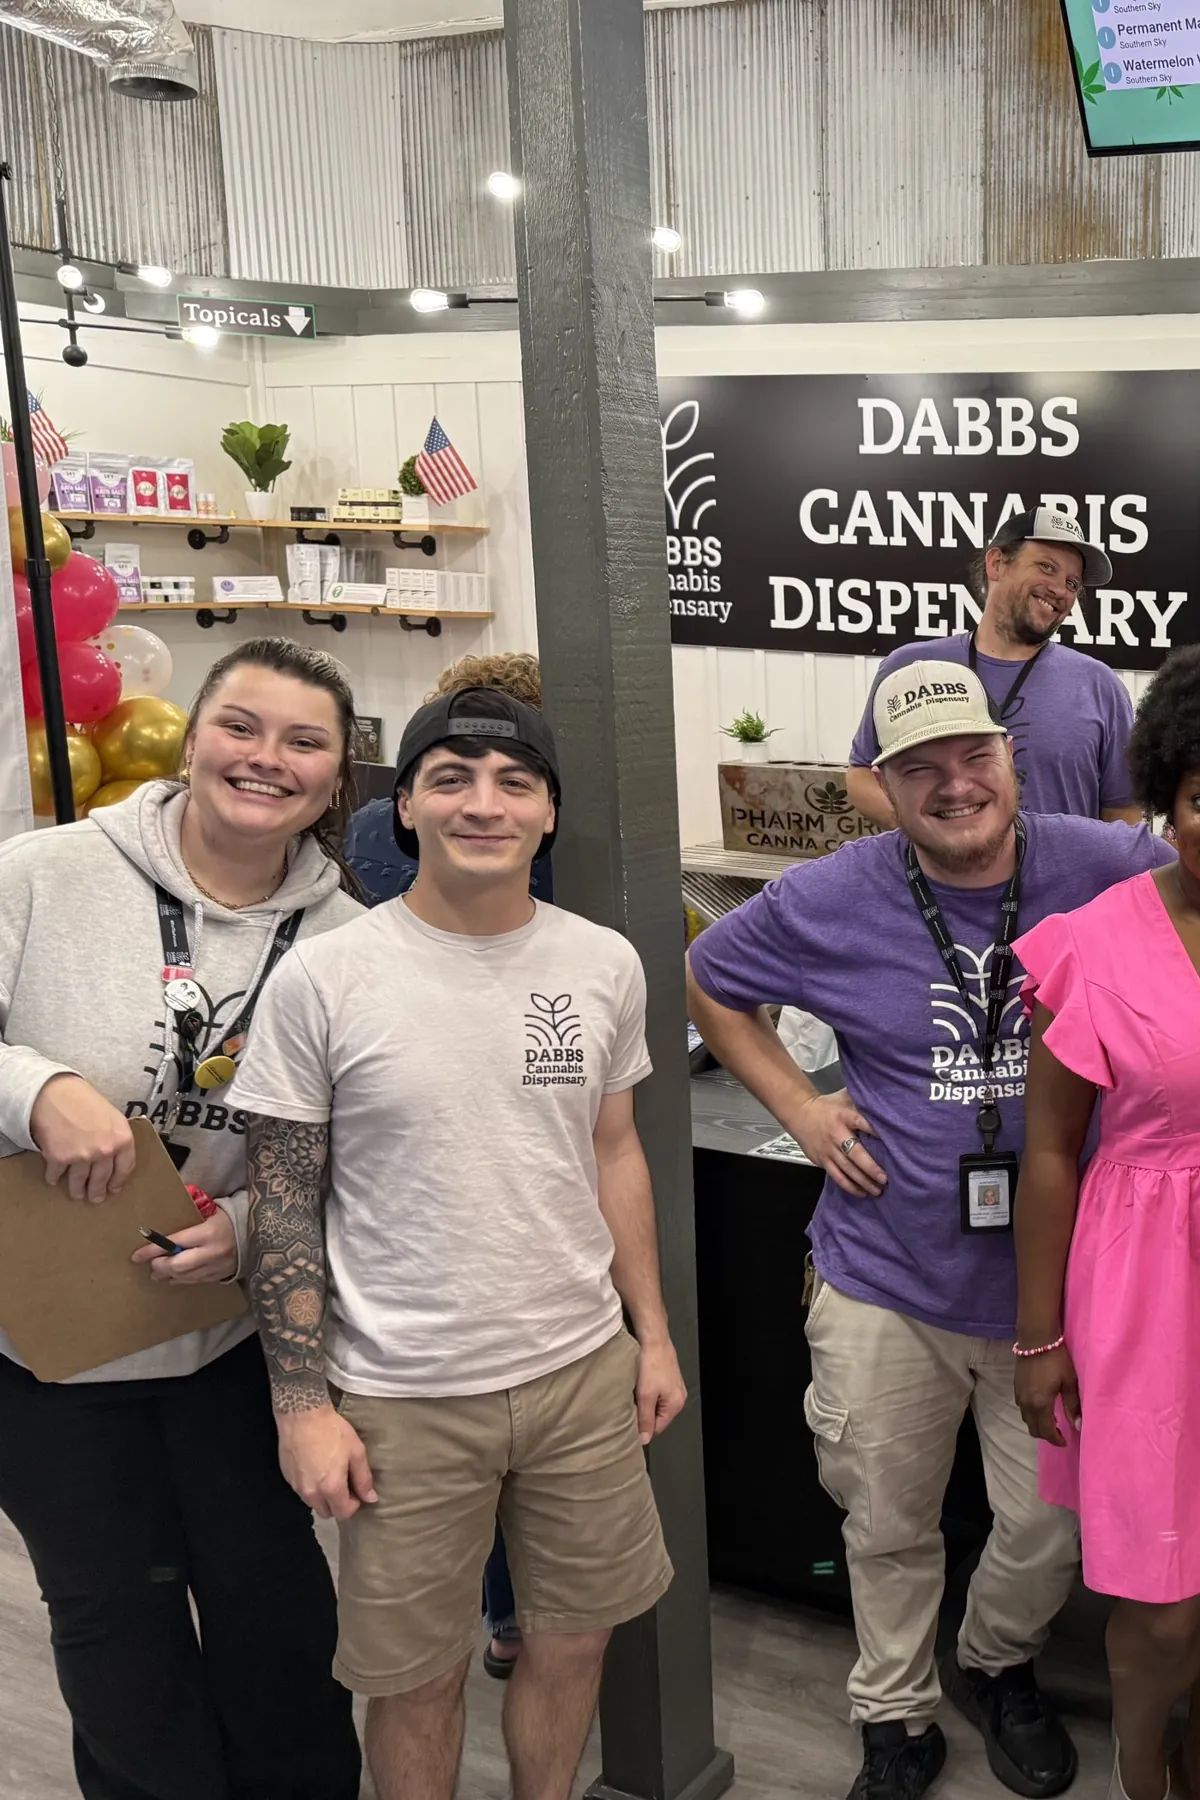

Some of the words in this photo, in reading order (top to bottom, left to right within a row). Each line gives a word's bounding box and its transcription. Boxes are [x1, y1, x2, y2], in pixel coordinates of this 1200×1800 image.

[1113, 4, 1147, 14] Southern
[1147, 1, 1161, 12] Sky
[1117, 19, 1183, 36] Permanent
[1120, 39, 1153, 49] Southern
[1153, 38, 1167, 48] Sky
[1122, 54, 1195, 72] Watermelon
[1125, 74, 1158, 85] Southern
[1159, 73, 1173, 84] Sky
[183, 303, 281, 328] Topicals
[857, 396, 1080, 457] DABBS
[666, 535, 722, 568] BBS
[668, 567, 722, 593] nabis
[669, 598, 733, 624] nsary
[768, 576, 1188, 649] DISPENARY
[904, 682, 968, 705] DABBS
[889, 702, 922, 723] Cannabis
[925, 696, 970, 706] Dispensary
[730, 807, 825, 833] PHARM
[837, 816, 882, 836] GR
[746, 833, 818, 850] CANNA
[524, 1048, 584, 1063] DABBS
[522, 1074, 588, 1087] Dispensary
[526, 1063, 584, 1075] Cannabis
[935, 1060, 1028, 1083] Canabi
[929, 1082, 1026, 1105] Dispensa
[125, 1099, 245, 1135] DABBS
